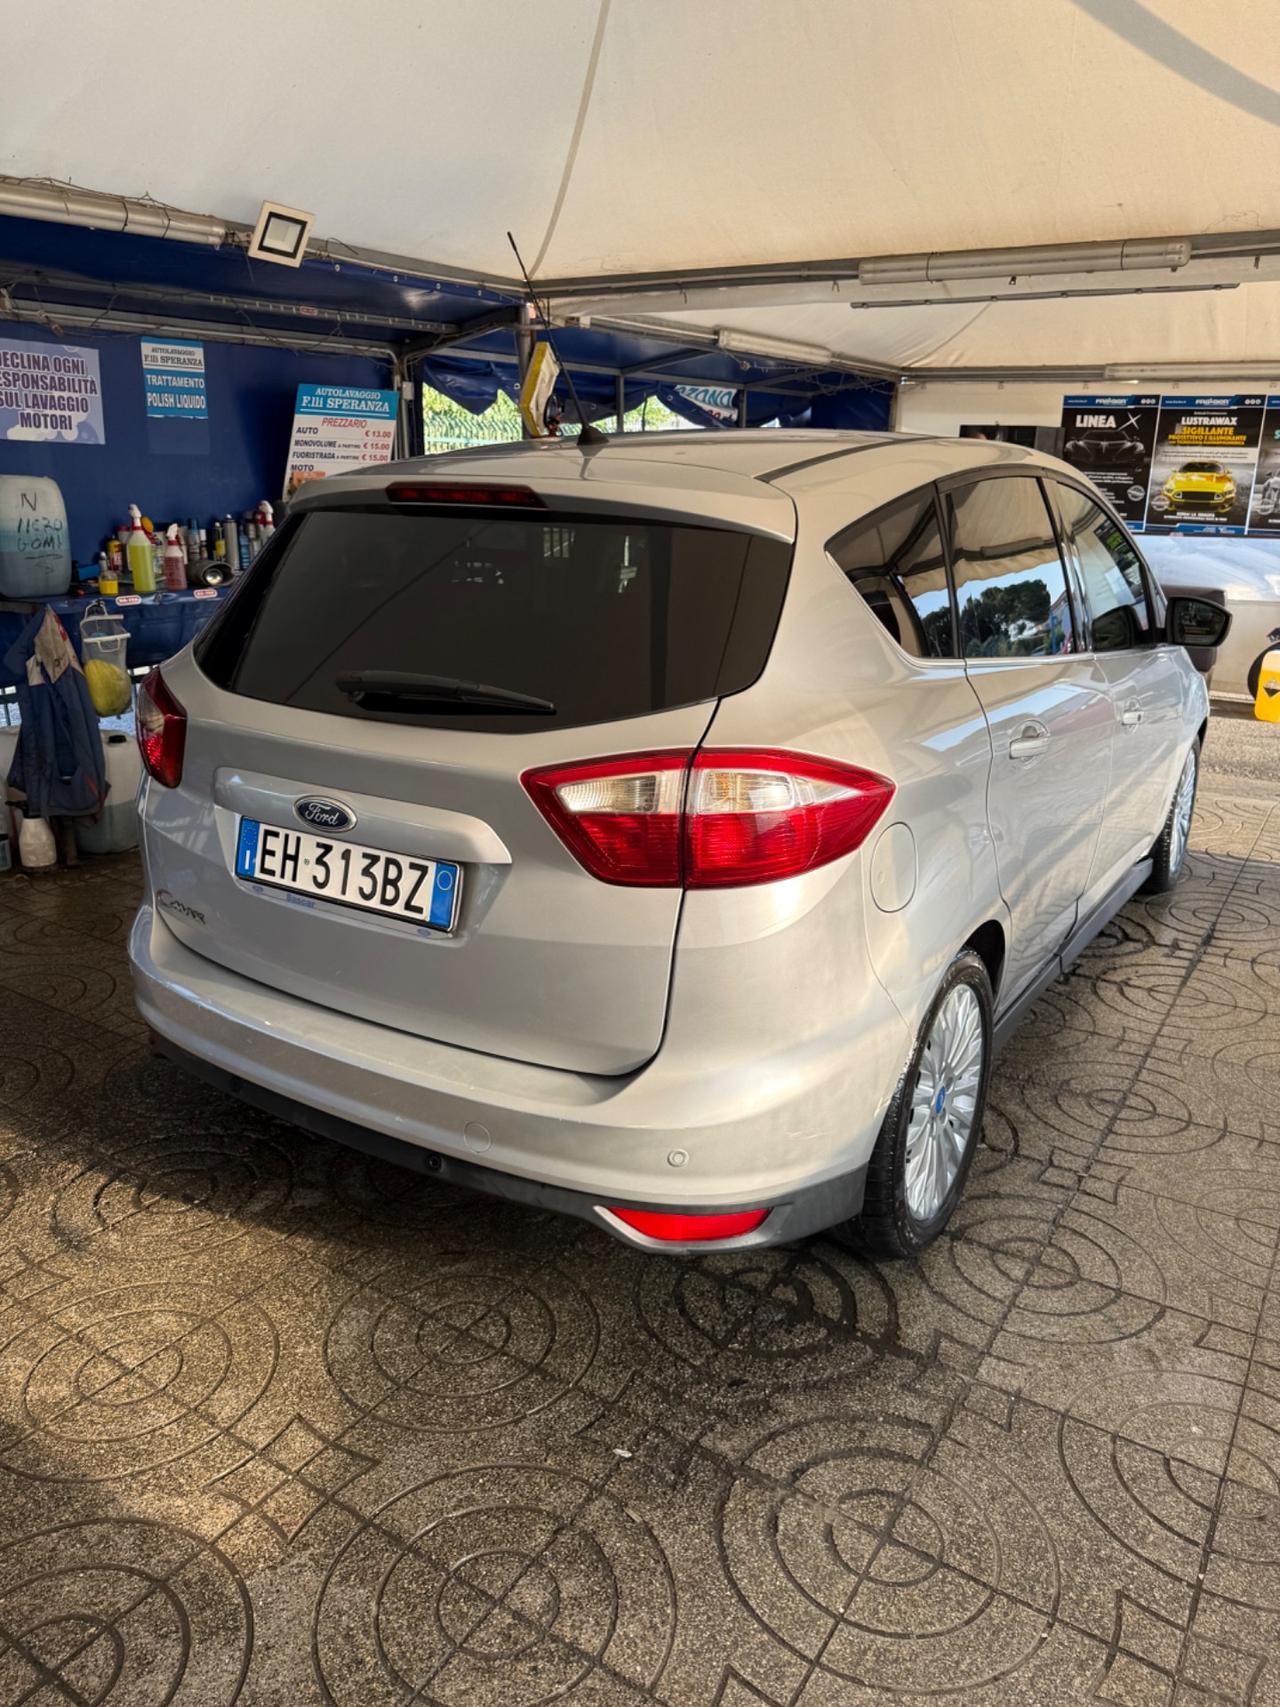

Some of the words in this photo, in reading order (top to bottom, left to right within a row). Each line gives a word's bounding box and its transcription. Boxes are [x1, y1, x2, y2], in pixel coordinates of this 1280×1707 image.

[151, 347, 196, 357] AUTOLAVAGGIO
[53, 356, 85, 375] OGNI
[160, 356, 203, 367] SPERANZA
[145, 375, 205, 389] TRATTAMENTO
[315, 387, 381, 399] AUTOLAVAGGIO
[24, 393, 89, 414] LAVAGGIO
[146, 392, 174, 408] POLISH
[176, 394, 207, 409] LIQUIDO
[301, 395, 323, 408] F.lli
[326, 396, 390, 412] SPERANZA
[19, 411, 73, 430] MOTORI
[320, 417, 368, 429] PREZZARIO
[1075, 414, 1117, 428] LINEA
[1180, 416, 1239, 426] LUSTRAWAX
[295, 426, 319, 435] AUTO
[1182, 426, 1235, 435] SIGILLANTE
[293, 439, 337, 449] MONOVOLUME
[291, 450, 336, 460] FUORISTRADA
[361, 453, 367, 461] €
[289, 464, 314, 472] MOTO
[304, 801, 340, 826] Ford
